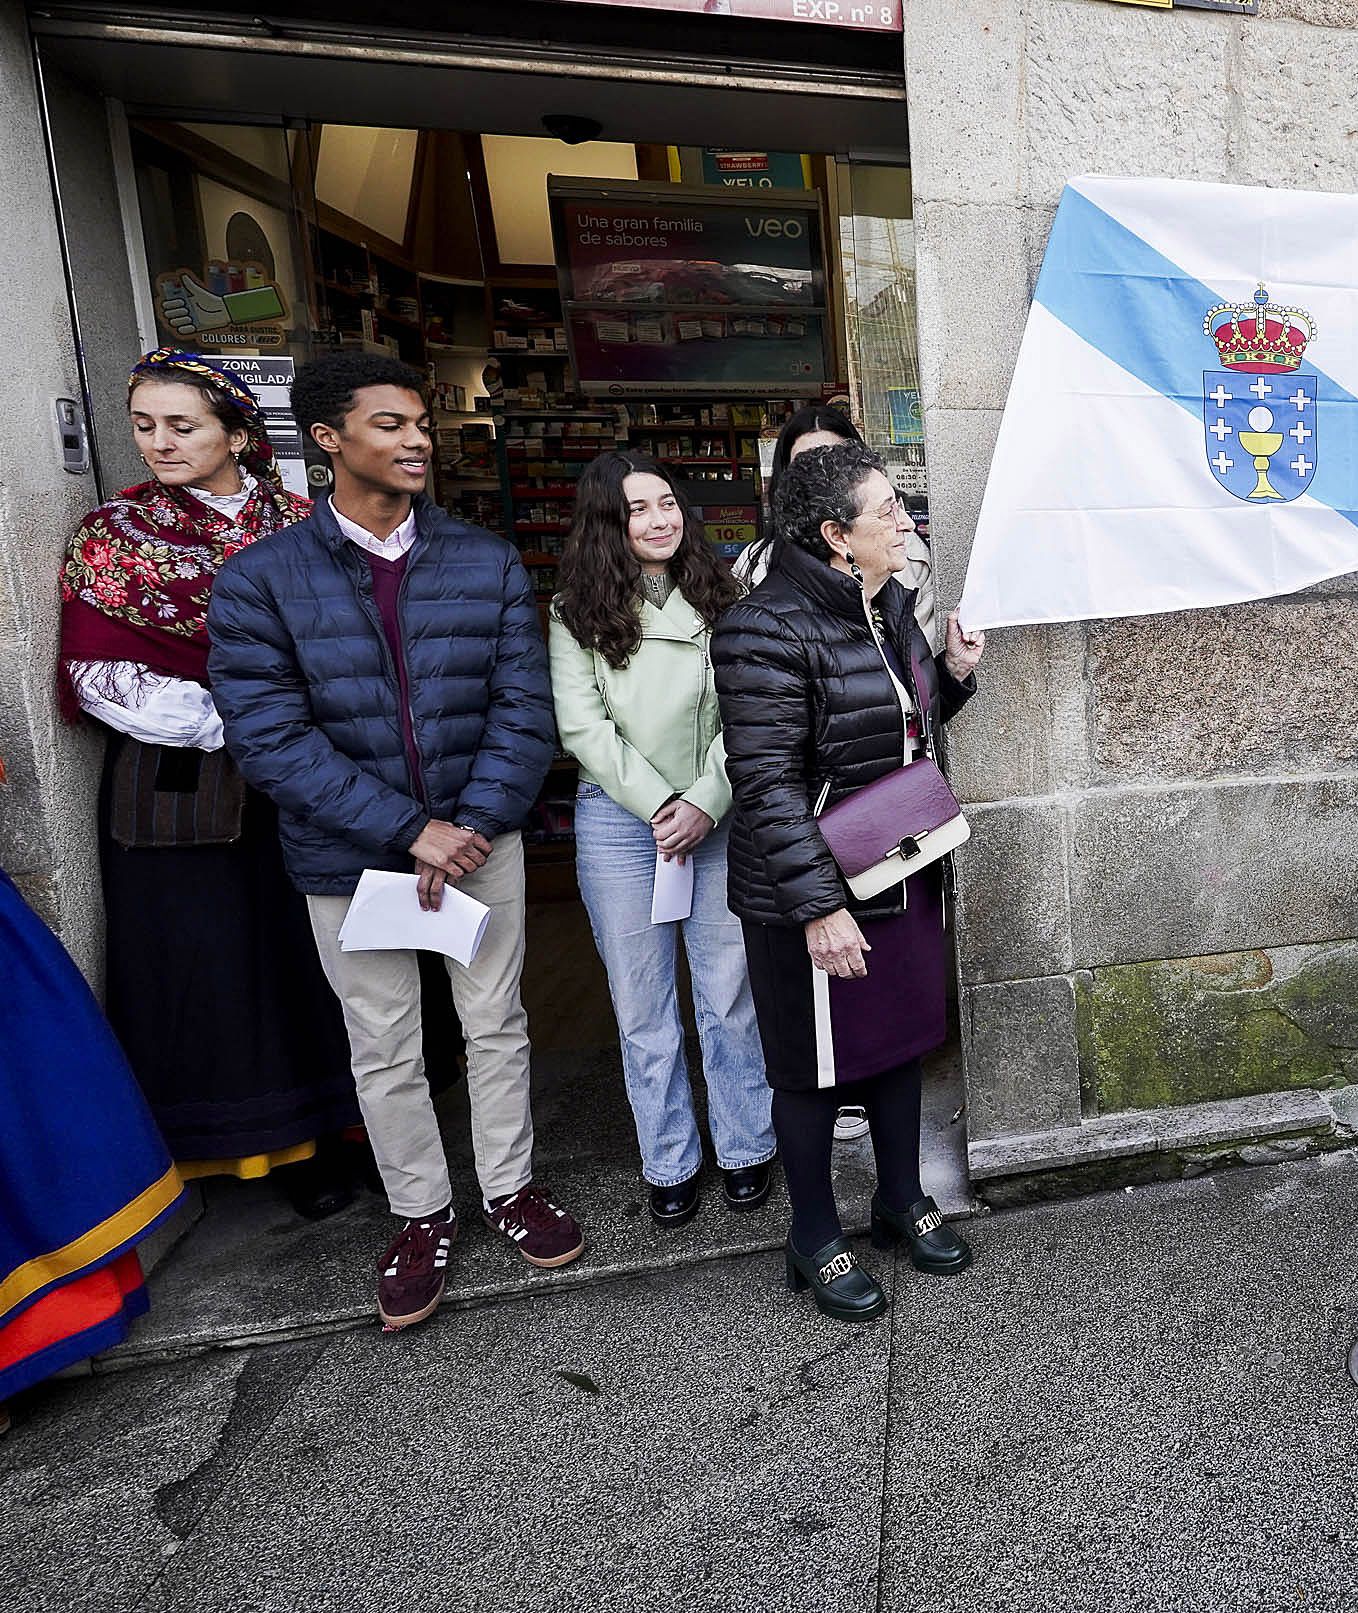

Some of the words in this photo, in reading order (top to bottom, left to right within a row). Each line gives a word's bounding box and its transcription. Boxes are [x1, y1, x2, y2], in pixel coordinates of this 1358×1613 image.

[793, 0, 843, 21] EXP.
[880, 7, 892, 25] 8
[577, 214, 609, 228] Una
[612, 217, 649, 233] gran
[653, 217, 704, 233] familia
[745, 217, 802, 238] veo
[579, 232, 601, 245] de
[606, 233, 668, 247] sabores
[201, 333, 246, 344] COLORES
[222, 361, 261, 371] ZONA
[238, 373, 295, 385] IGILADA
[714, 527, 745, 541] 10€
[724, 543, 739, 553] 5€
